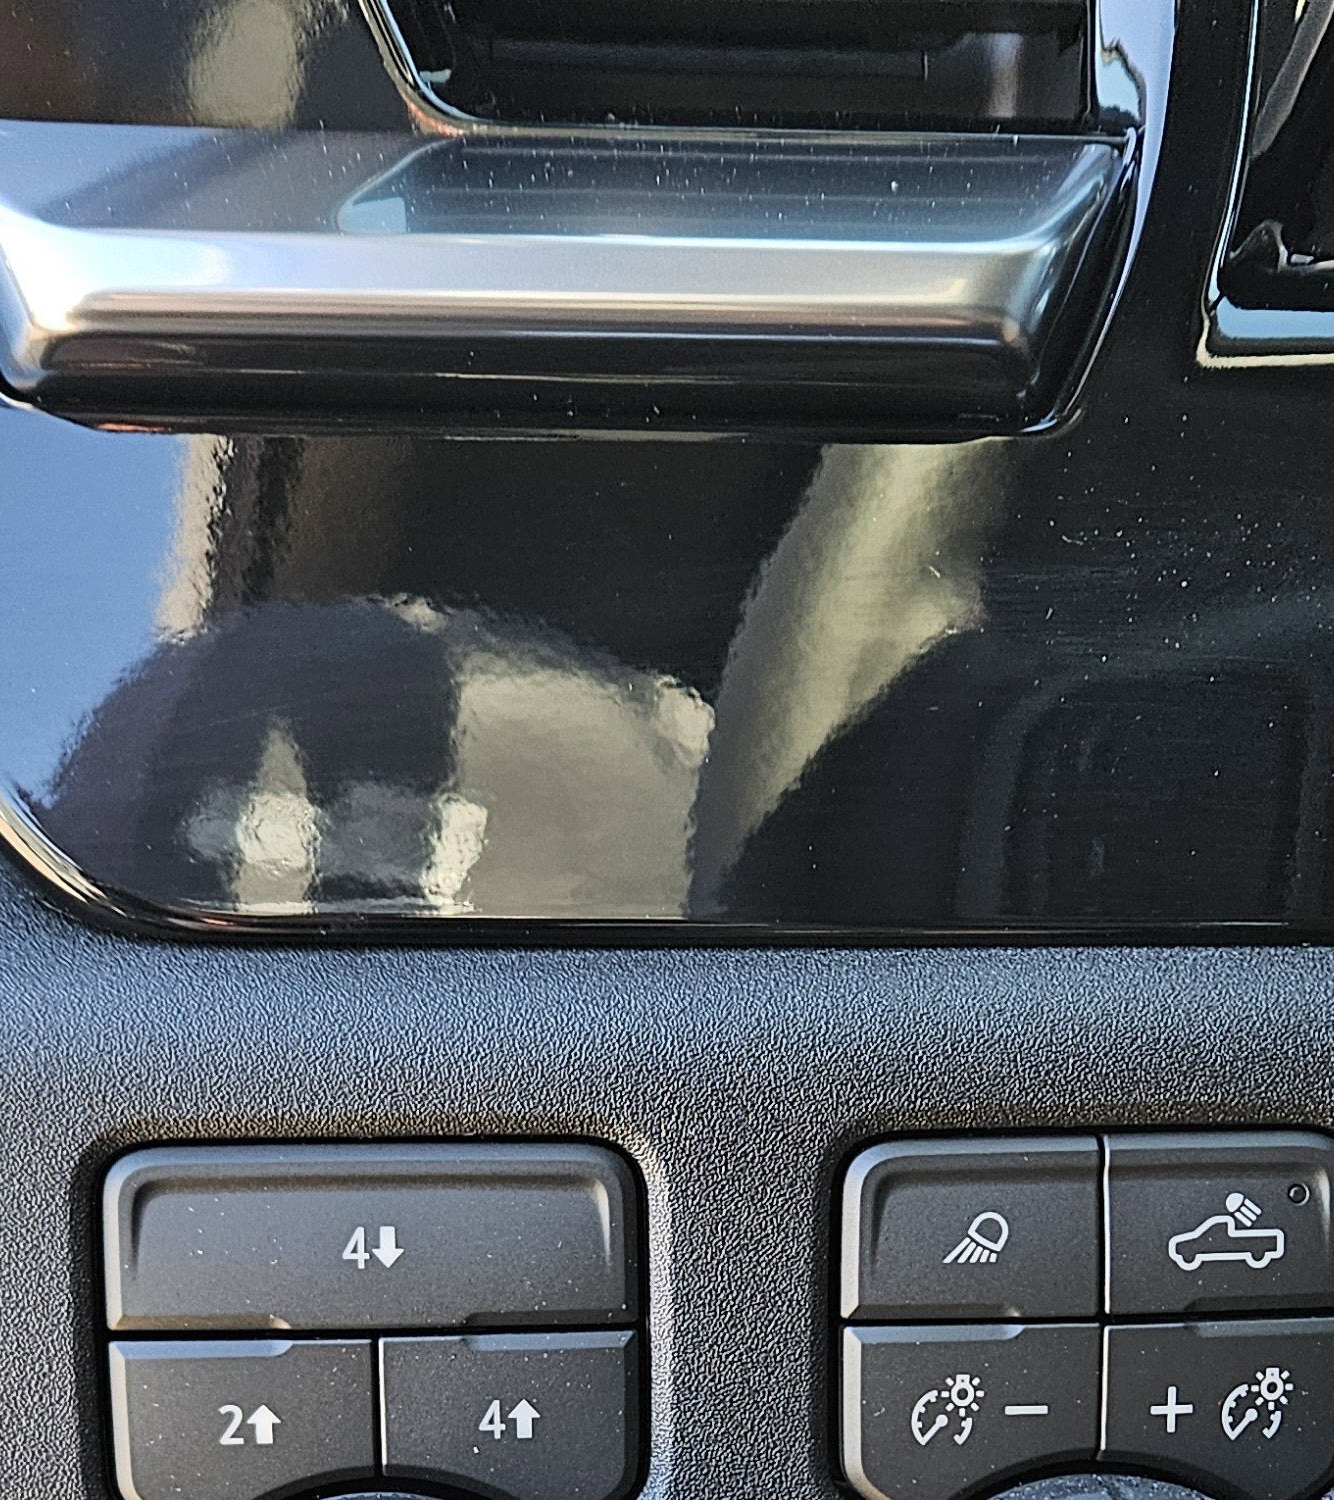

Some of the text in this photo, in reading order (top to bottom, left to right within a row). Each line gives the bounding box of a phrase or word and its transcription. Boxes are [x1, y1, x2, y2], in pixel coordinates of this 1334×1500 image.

[342, 1227, 371, 1270] 4
[218, 1404, 246, 1446] 2
[479, 1397, 506, 1440] 4
